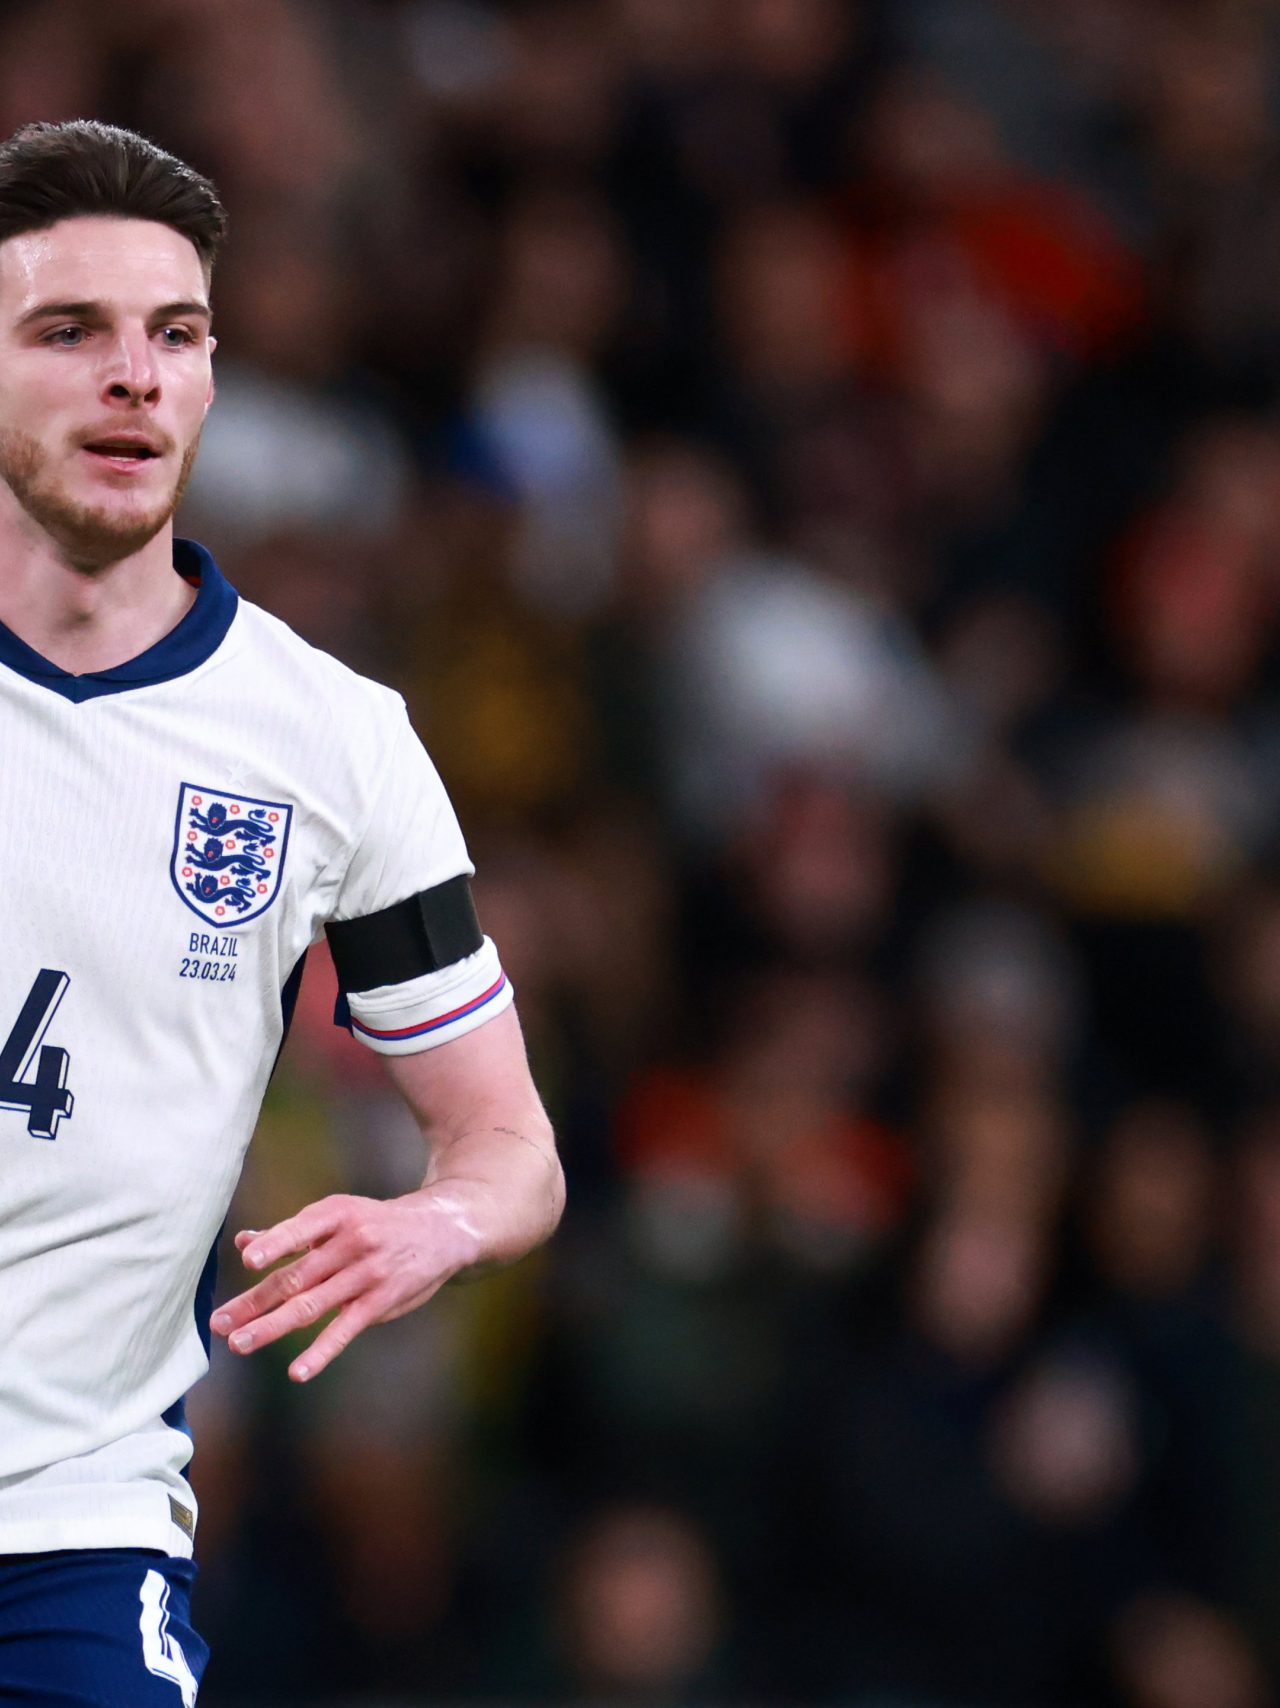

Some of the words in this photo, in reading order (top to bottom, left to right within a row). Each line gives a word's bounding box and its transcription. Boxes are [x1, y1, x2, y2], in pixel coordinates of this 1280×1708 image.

[189, 932, 238, 957] BRAZIL
[179, 957, 237, 981] 23.03.24
[139, 1569, 198, 1708] 4
